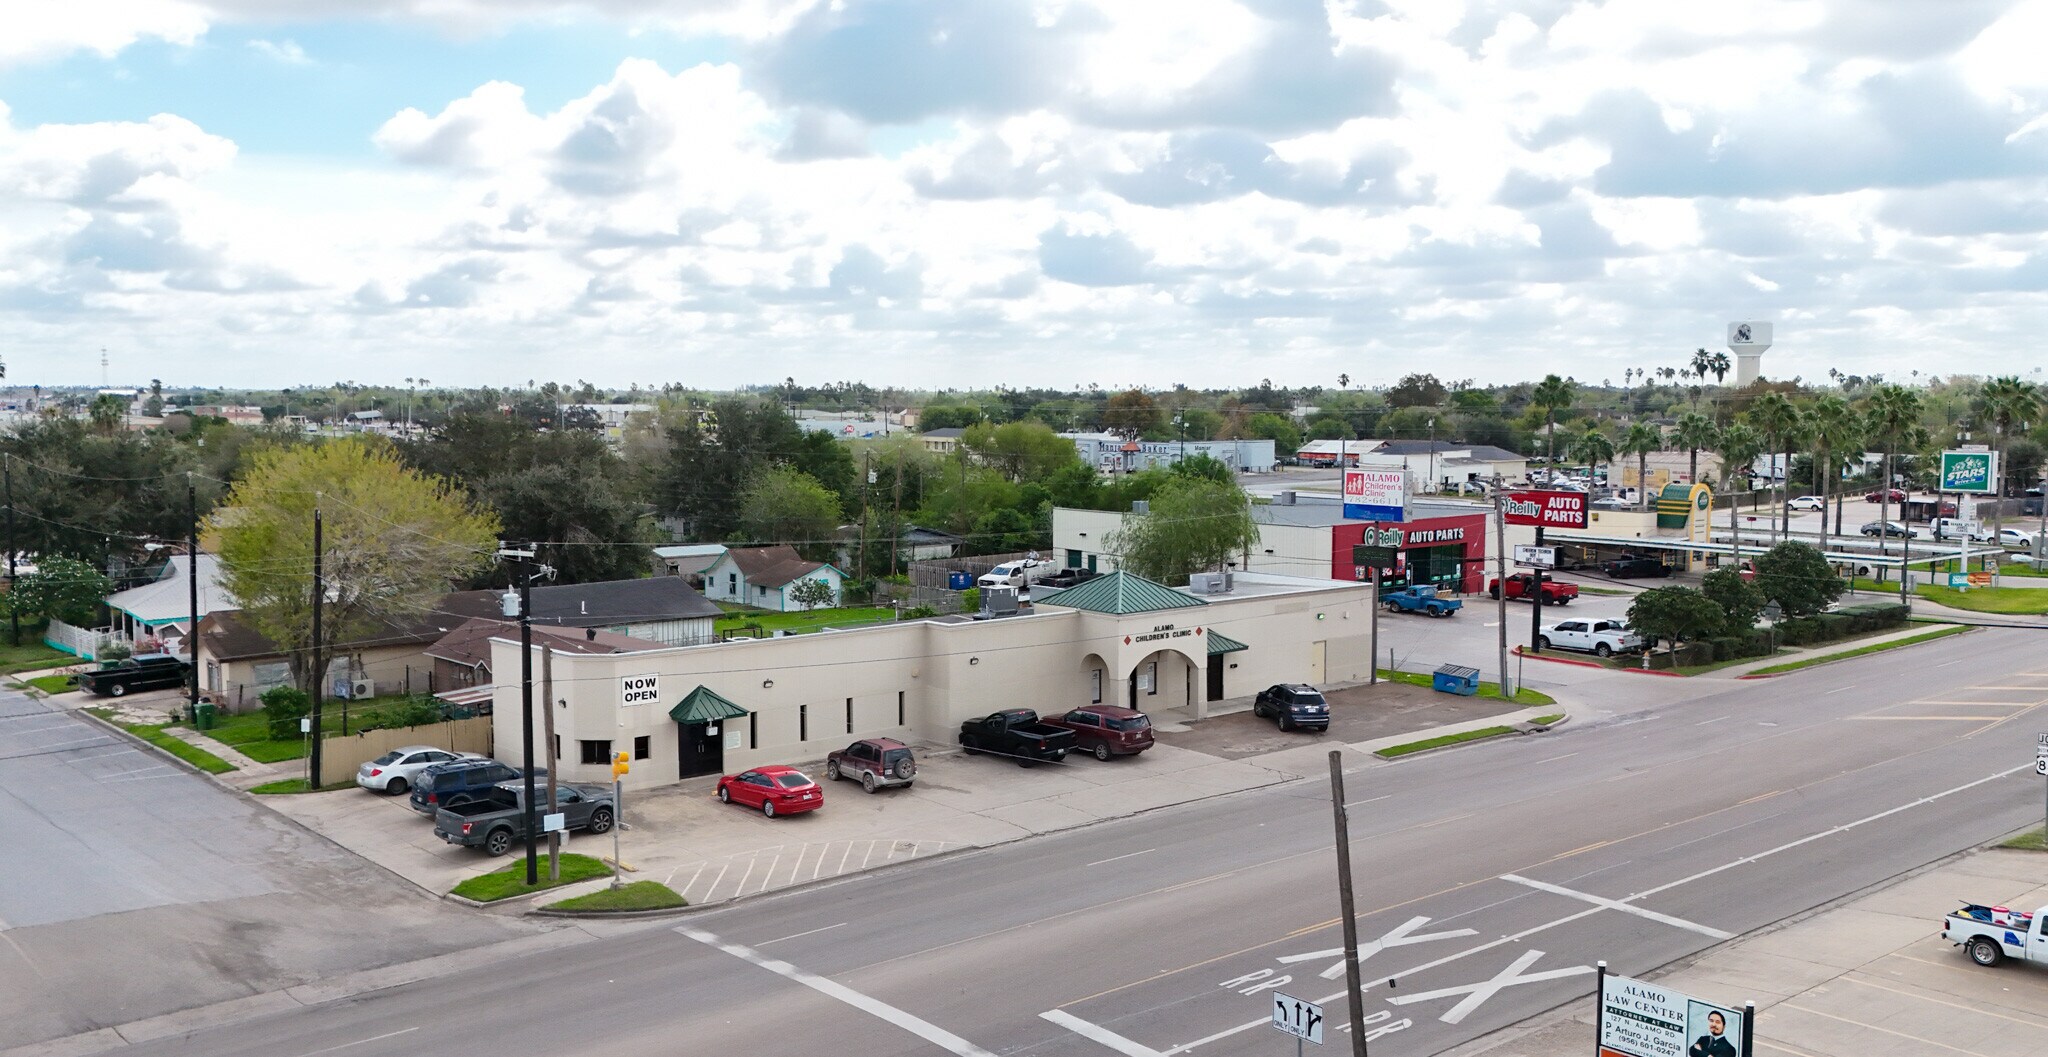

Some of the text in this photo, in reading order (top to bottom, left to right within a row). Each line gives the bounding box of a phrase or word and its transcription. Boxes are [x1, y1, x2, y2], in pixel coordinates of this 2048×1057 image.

[1365, 473, 1400, 482] ALAMO
[1947, 467, 1986, 480] STARS
[1364, 482, 1402, 491] Children's
[1548, 497, 1580, 510] AUTO
[1544, 509, 1583, 523] PARTS
[1409, 531, 1433, 544] AUTO
[1436, 528, 1464, 541] PARTS
[1154, 624, 1174, 632] ALAMO
[1135, 630, 1192, 643] CHILDREN'S CLINIC
[624, 677, 656, 691] NOW
[624, 690, 657, 702] OPEN
[1624, 985, 1666, 1003] ALAMO
[1606, 993, 1684, 1022] LAW CENTER
[1274, 1019, 1288, 1030] ONLY
[1609, 1008, 1647, 1022] ATTORNEY
[1664, 1023, 1680, 1031] LAW
[1610, 1014, 1621, 1023] 127
[1635, 1022, 1662, 1034] ALAMO
[1291, 1025, 1304, 1036] ONLY
[1606, 1021, 1681, 1051] P Arturo J. Garcia
[1618, 1036, 1638, 1047] (956)
[1640, 1042, 1676, 1056] 601-0247
